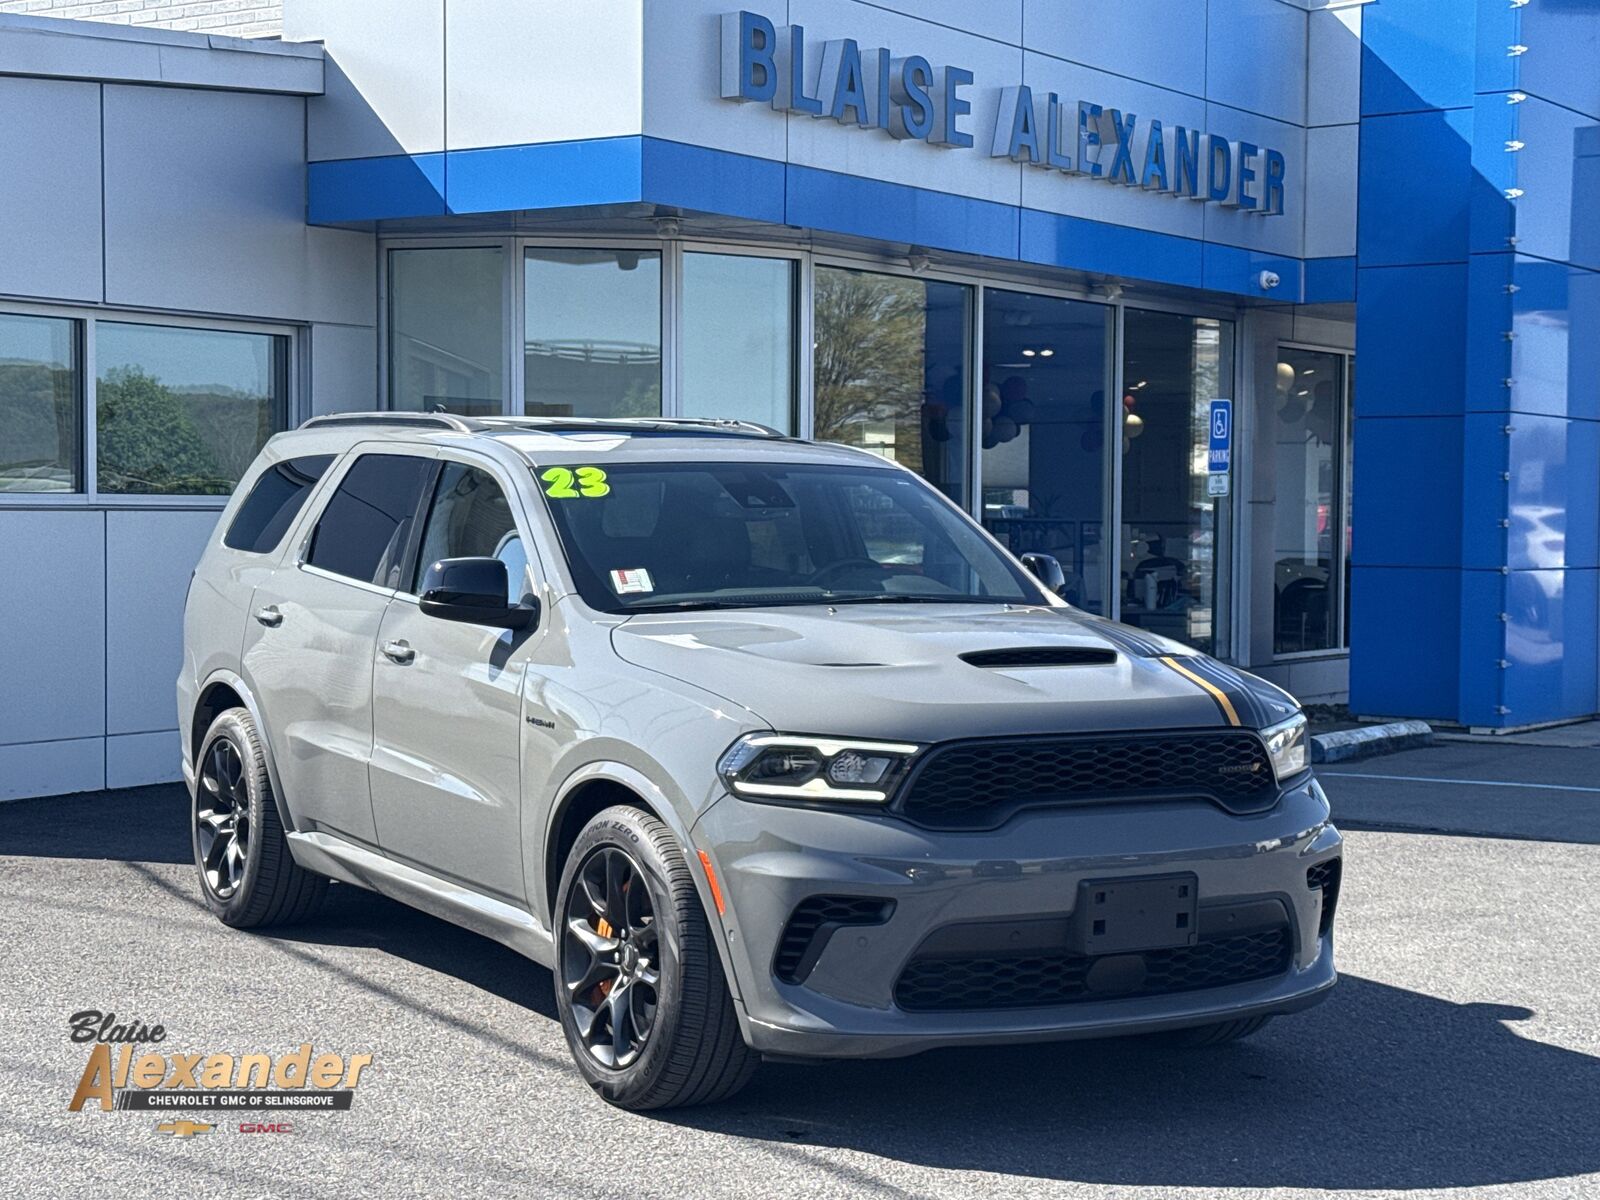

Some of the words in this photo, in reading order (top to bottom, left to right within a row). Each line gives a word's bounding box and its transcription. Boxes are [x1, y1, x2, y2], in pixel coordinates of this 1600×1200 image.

[738, 9, 974, 148] BLAISE
[1007, 84, 1286, 216] ALEXANDER
[541, 466, 610, 498] 23
[611, 820, 640, 844] ZERO
